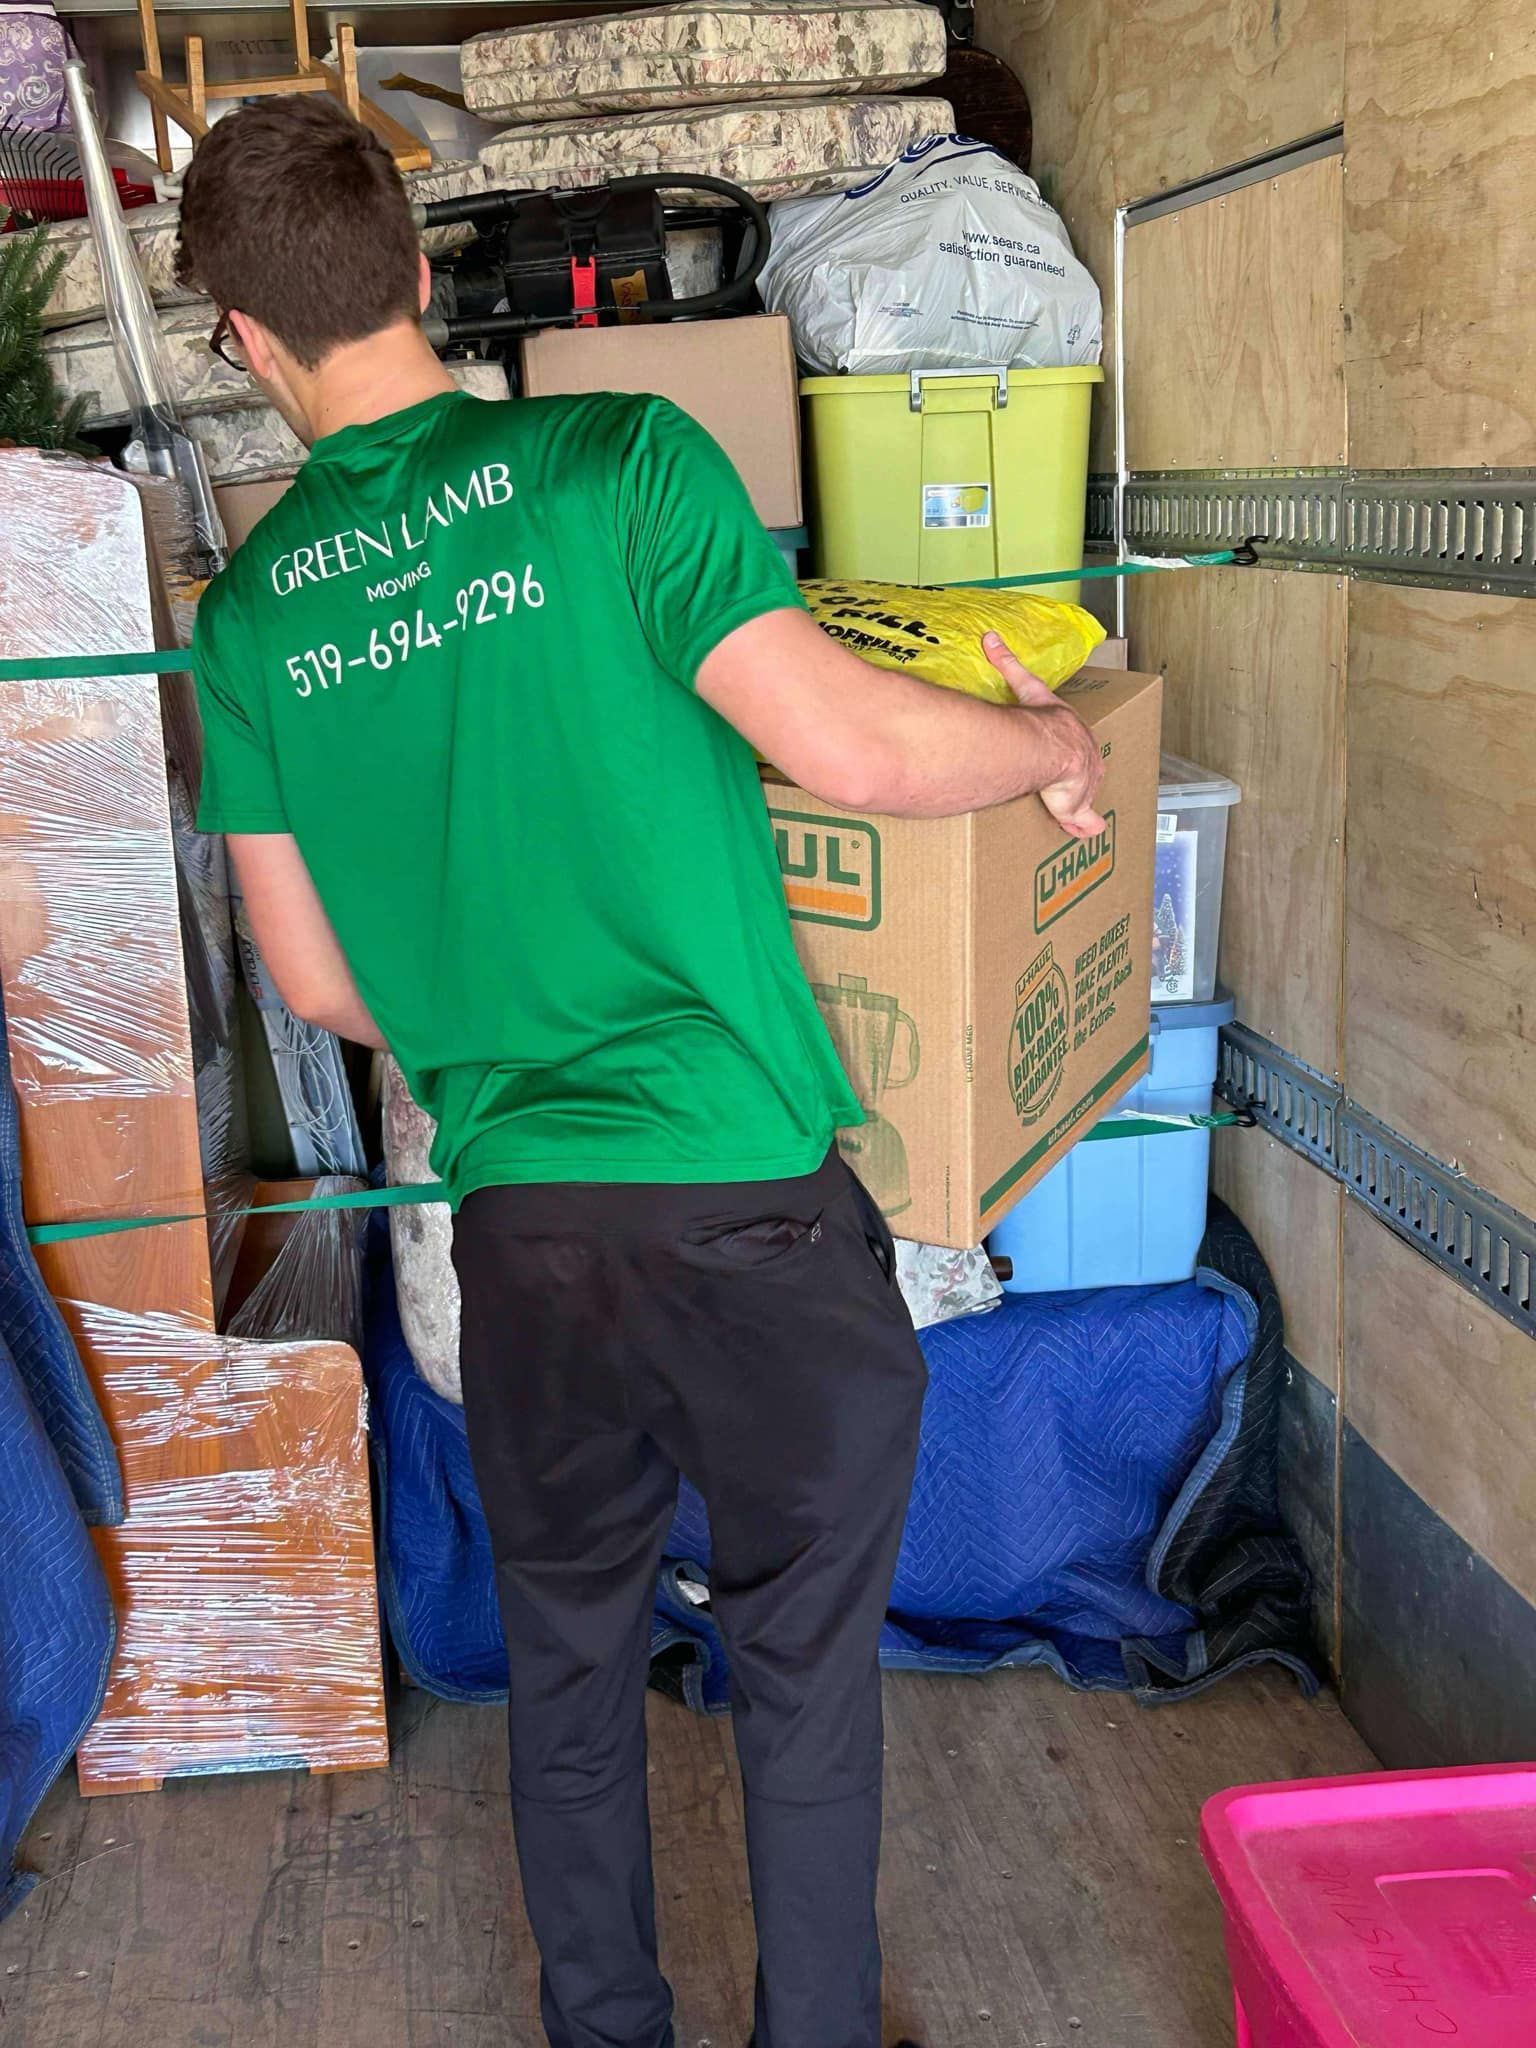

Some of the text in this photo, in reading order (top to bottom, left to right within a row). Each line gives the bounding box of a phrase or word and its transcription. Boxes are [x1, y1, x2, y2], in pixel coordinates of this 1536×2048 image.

[953, 175, 993, 191] VALUE,
[962, 230, 1040, 255] www.sears.ca
[1004, 254, 1065, 277] guaranteed
[271, 463, 514, 596] GREEN LAMB
[366, 561, 431, 602] MOVING
[286, 563, 545, 697] 519-694-9296
[1040, 829, 1110, 903] U-HAUL
[1014, 1006, 1066, 1091] BUY-BACK
[1016, 974, 1059, 1053] 100%
[1016, 1035, 1070, 1116] GUARANTEE
